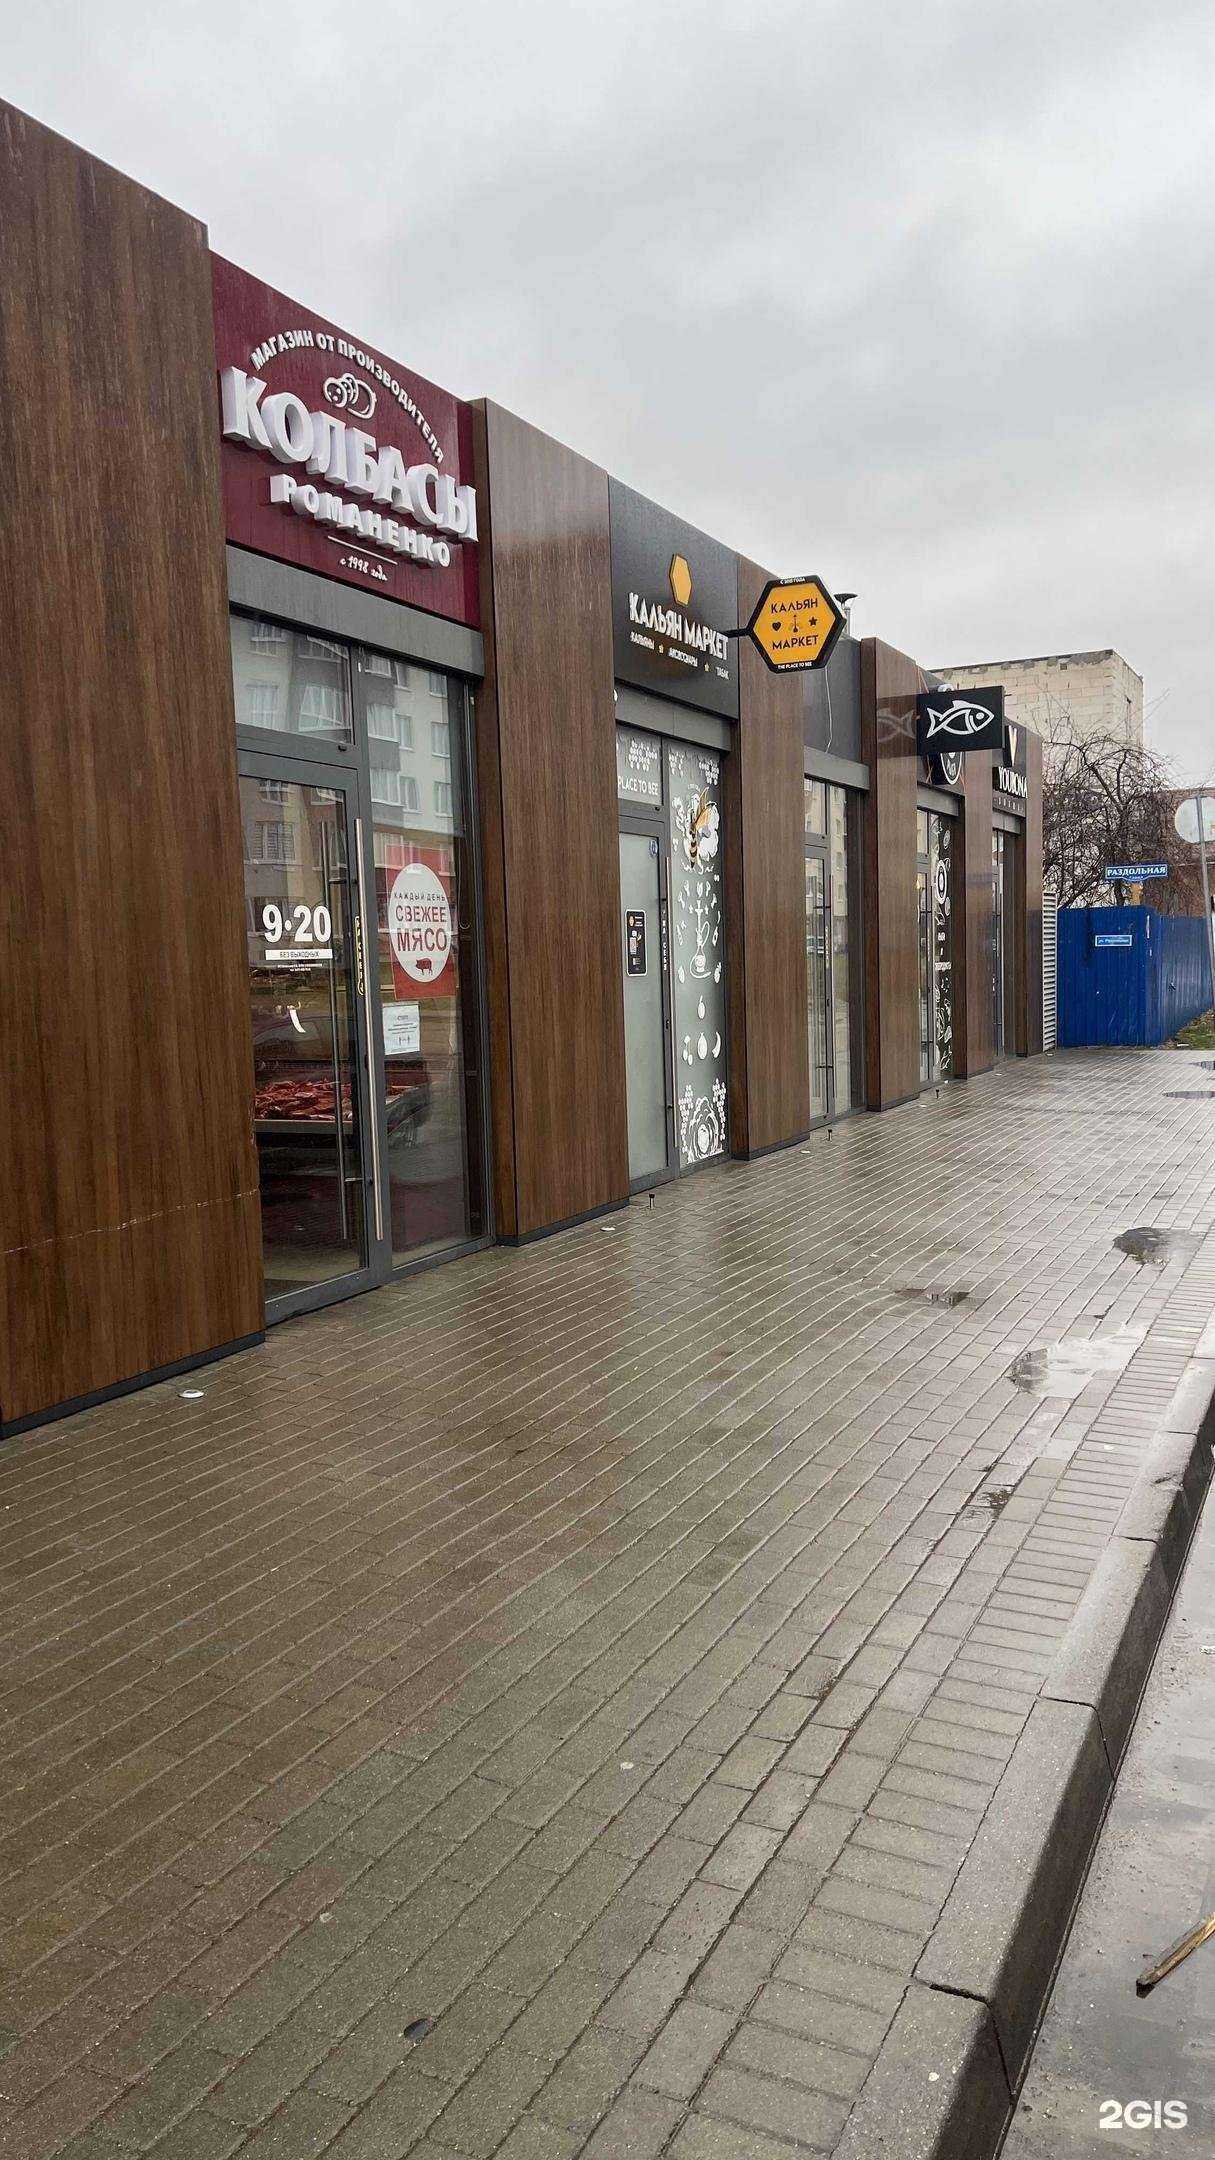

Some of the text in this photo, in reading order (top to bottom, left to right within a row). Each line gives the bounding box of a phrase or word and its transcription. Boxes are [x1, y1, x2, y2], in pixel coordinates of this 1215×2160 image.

[250, 329, 445, 464] МАГАЗИН ОТ ПРОИЗВОДИТЕЛЯ
[221, 366, 479, 542] КОЛБАСЫ
[270, 473, 451, 568] РОМАНЕНКО
[771, 597, 819, 614] КАЛЬЯН
[628, 592, 729, 661] КАЛЬЯН МАРКЕТ
[772, 634, 819, 651] МАРКЕТ
[617, 776, 638, 792] PLACE
[638, 779, 647, 793] TO
[1107, 866, 1166, 876] РАЗДОЛЬНАЯ
[396, 905, 447, 922] СВЕЖЕЕ
[397, 928, 447, 951] МЯСО
